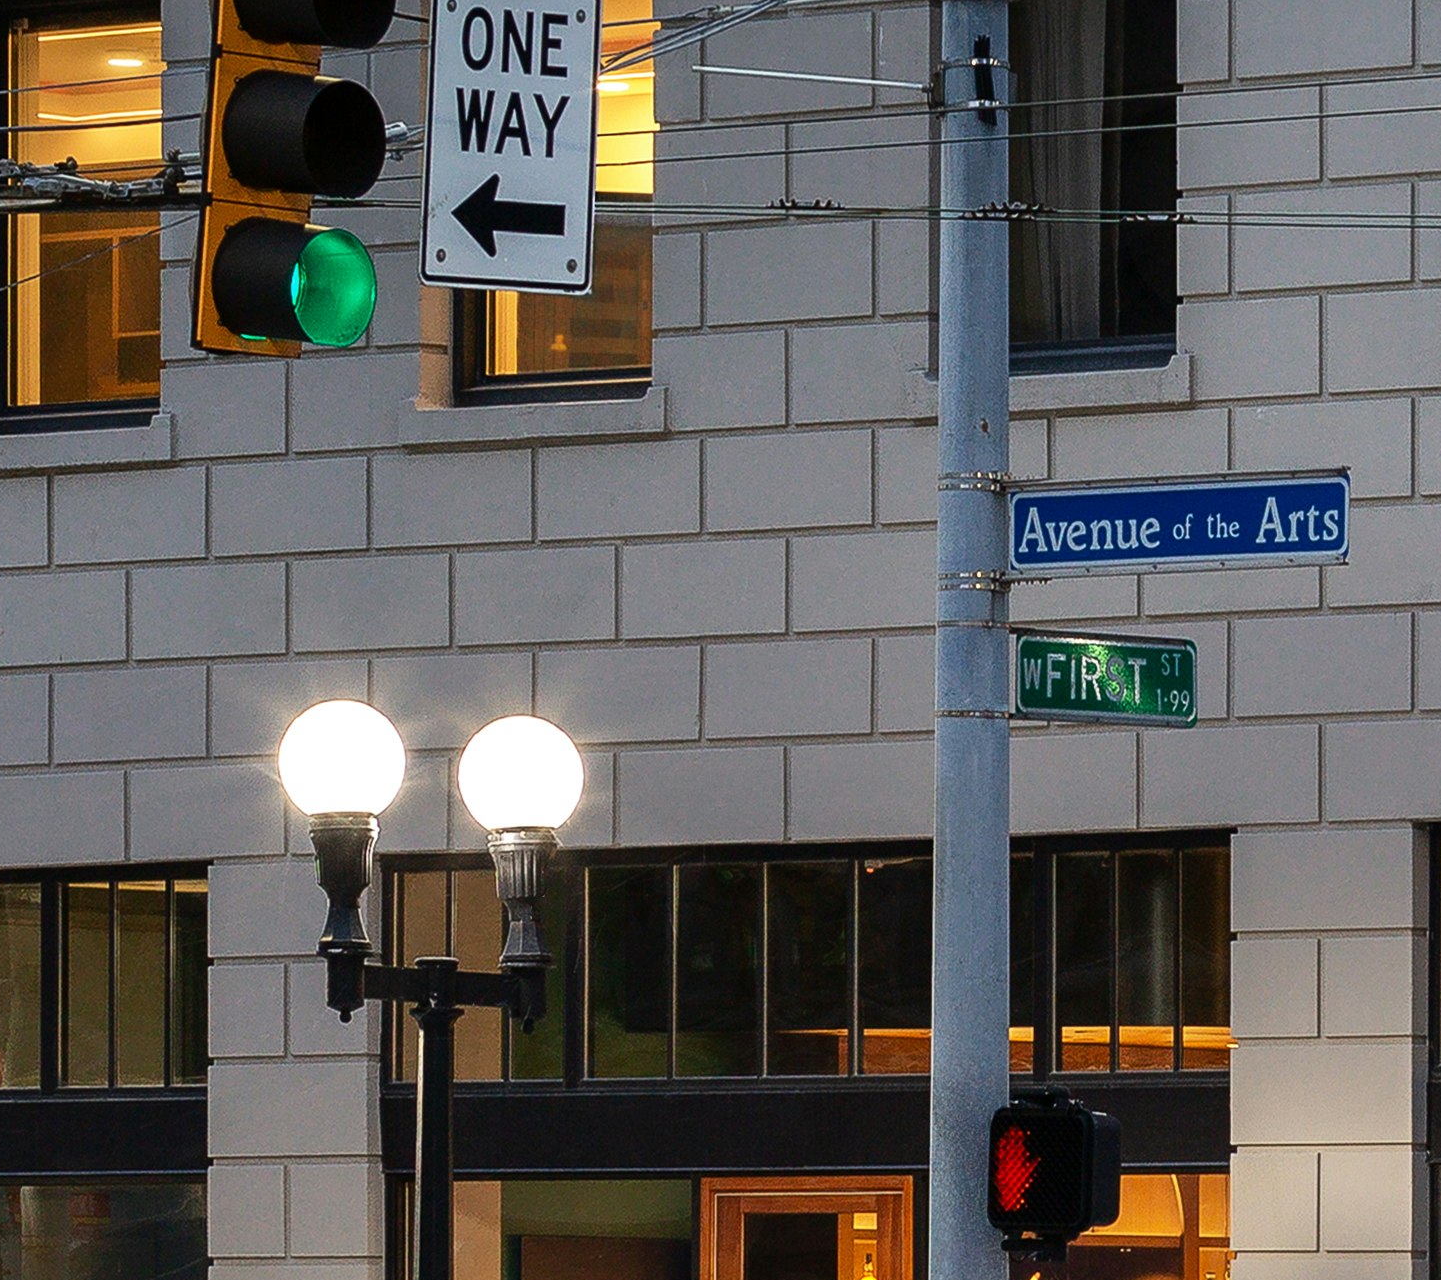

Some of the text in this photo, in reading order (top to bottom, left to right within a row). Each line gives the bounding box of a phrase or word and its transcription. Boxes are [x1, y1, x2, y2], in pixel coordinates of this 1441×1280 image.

[461, 6, 569, 78] ONE
[455, 86, 571, 159] WAY
[1018, 496, 1340, 553] Avenue of the Arts
[1022, 652, 1182, 705] W FIRST ST
